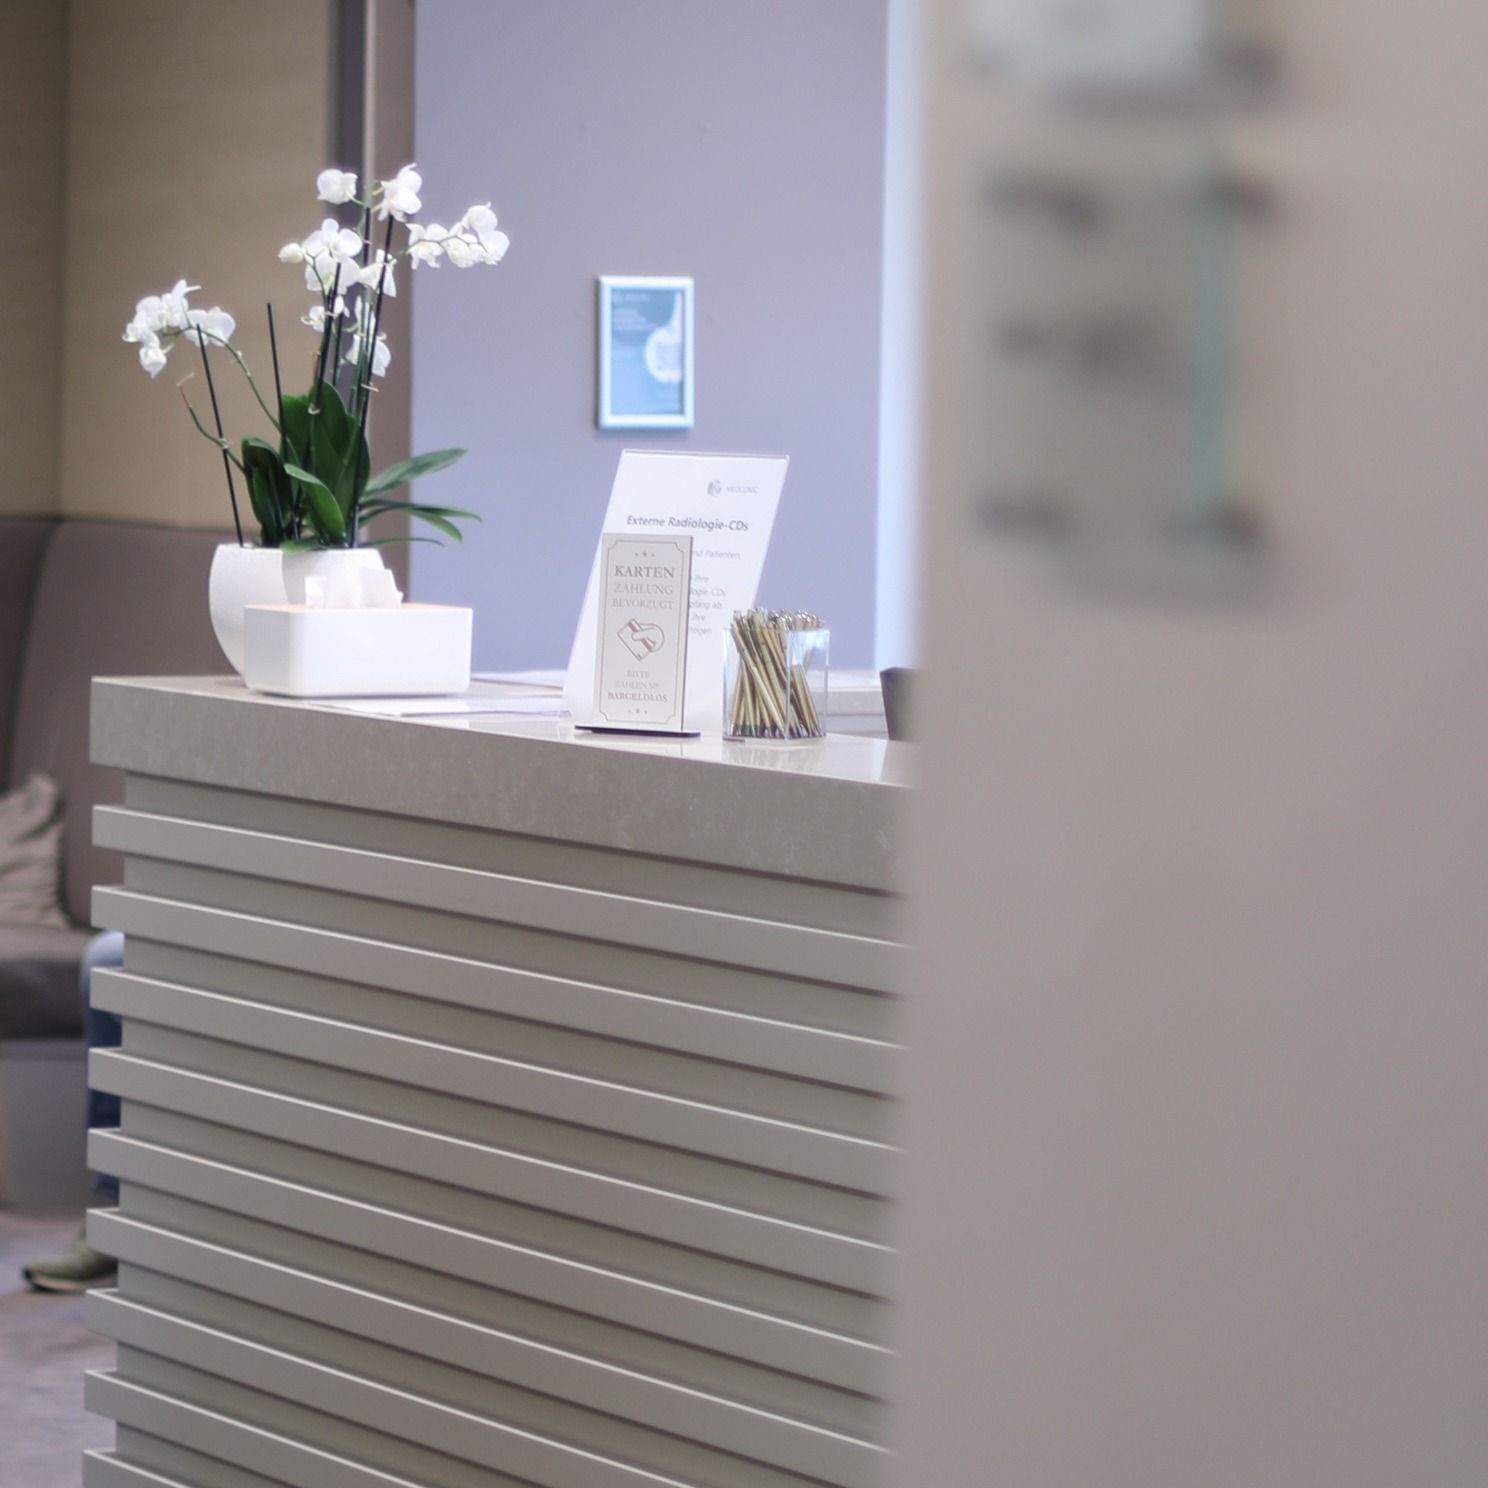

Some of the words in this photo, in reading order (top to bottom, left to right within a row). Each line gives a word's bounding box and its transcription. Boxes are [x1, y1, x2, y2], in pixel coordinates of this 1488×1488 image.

[626, 515, 665, 527] Externe
[667, 516, 748, 532] Radiologie-CDs
[614, 565, 675, 579] KARTEN
[613, 583, 673, 595] ZAHLUNG
[612, 599, 674, 610] BEVORZUGT
[607, 692, 669, 703] BARGELDLOS
